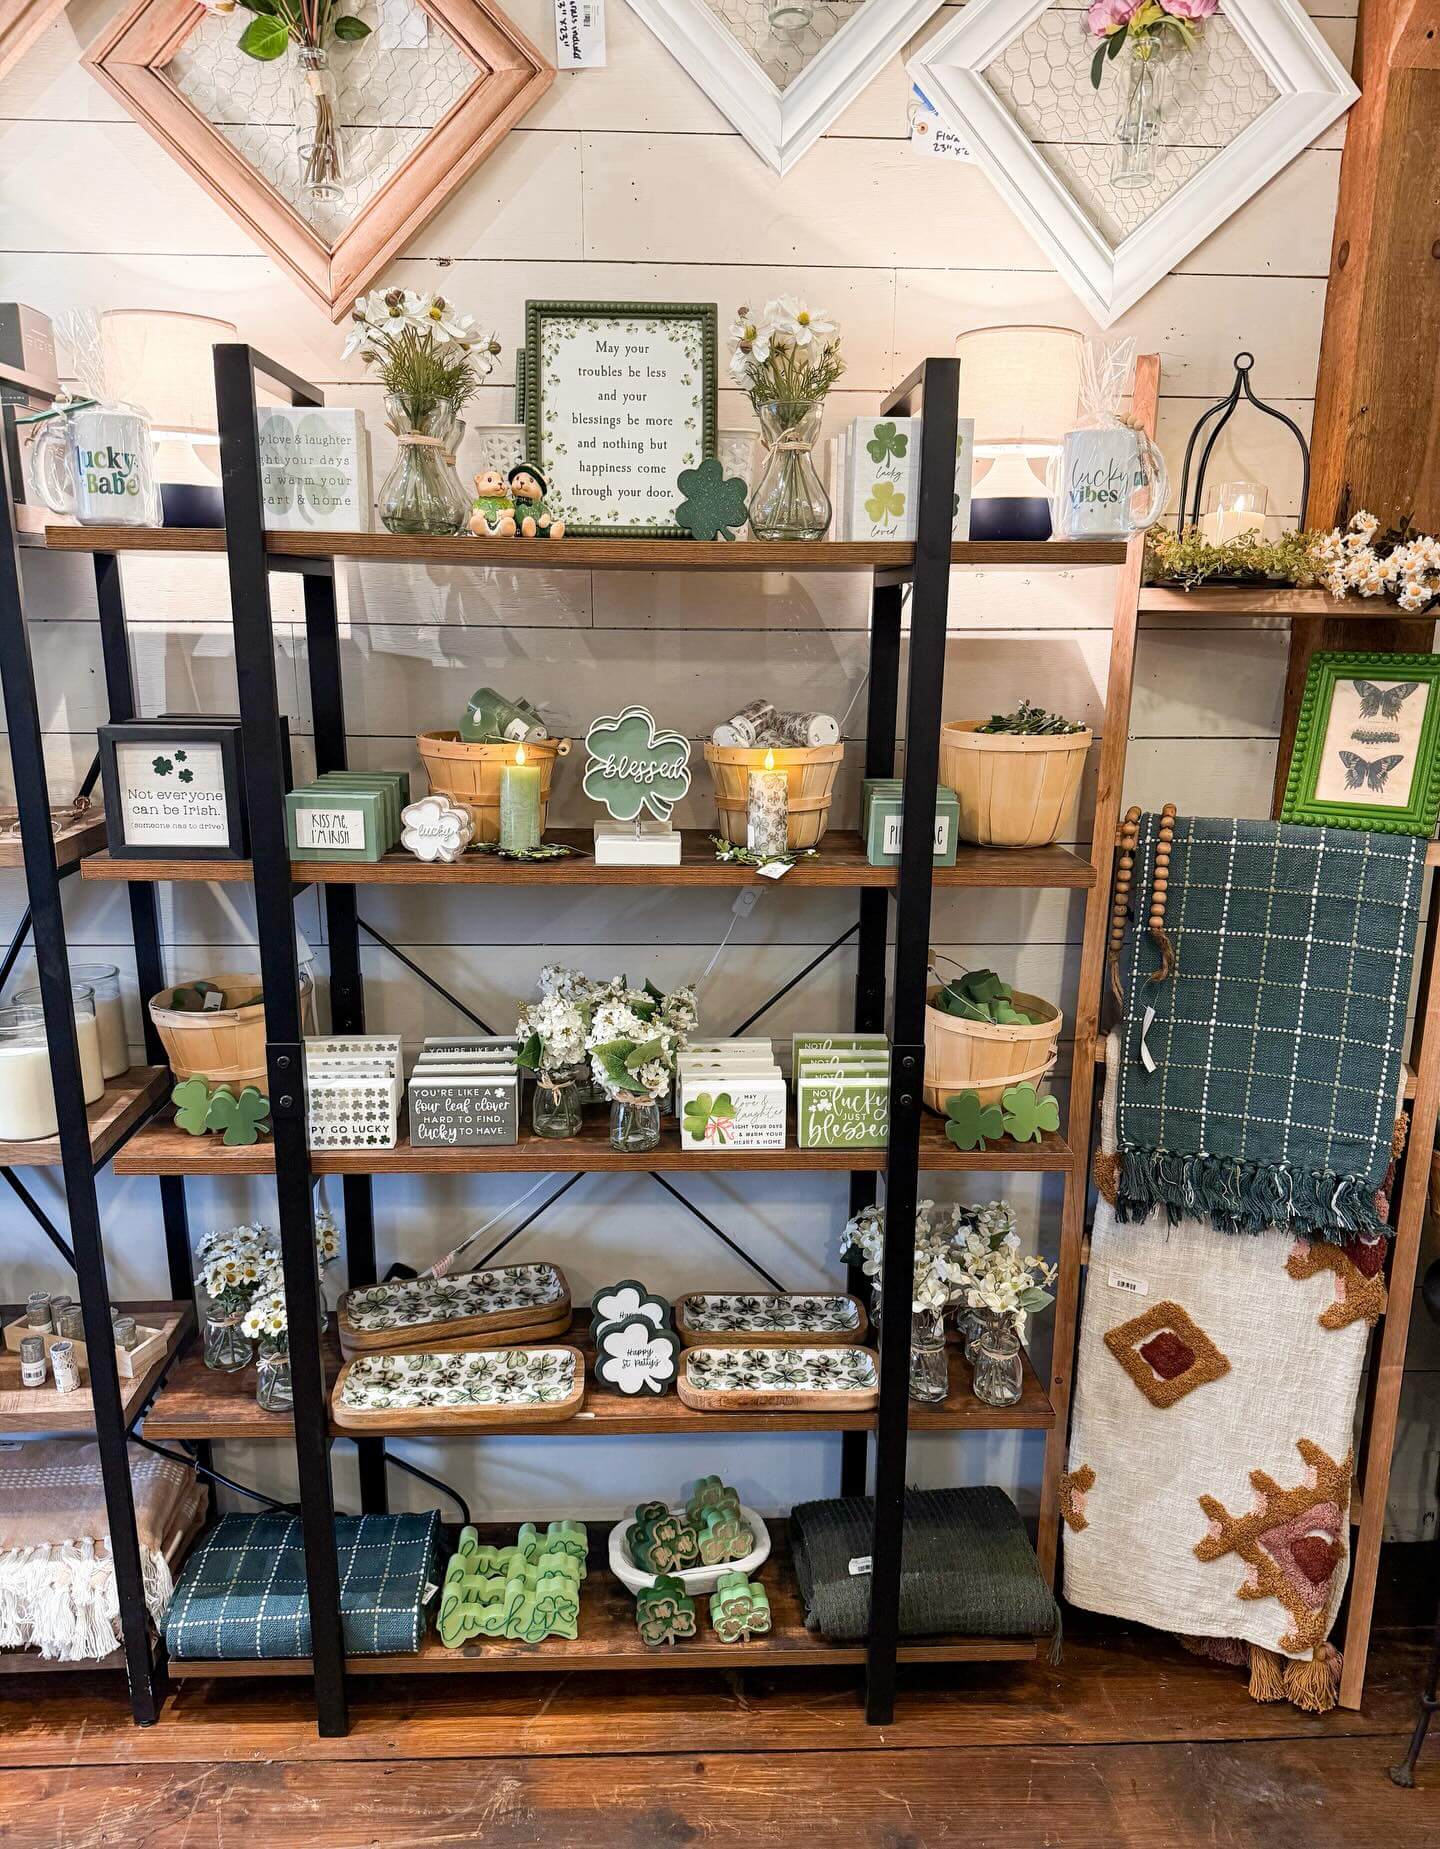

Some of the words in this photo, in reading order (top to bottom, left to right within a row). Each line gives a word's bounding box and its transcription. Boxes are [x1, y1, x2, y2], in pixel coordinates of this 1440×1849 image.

[595, 340, 620, 357] May
[624, 345, 650, 357] your
[578, 365, 623, 377] troubles
[628, 365, 641, 378] be
[647, 366, 667, 378] less
[597, 389, 617, 401] and
[622, 393, 648, 405] your
[571, 412, 621, 430] blessings
[627, 413, 640, 426] be
[645, 418, 673, 426] more
[267, 434, 292, 445] love
[294, 434, 301, 445] &
[304, 434, 352, 447] laughter
[577, 436, 597, 449] and
[602, 437, 644, 454] nothing
[650, 438, 668, 450] but
[284, 456, 315, 467] your
[319, 455, 350, 467] days
[579, 460, 632, 477] happiness
[637, 465, 667, 474] come
[278, 476, 316, 486] warm
[320, 476, 352, 488] your
[875, 465, 904, 483] lucky
[1071, 457, 1129, 496] lucky
[87, 471, 140, 496] Babe
[297, 494, 305, 505] &
[312, 494, 352, 506] home
[571, 484, 613, 501] through
[617, 489, 642, 501] your
[646, 485, 674, 498] door.
[870, 524, 898, 538] loved
[602, 753, 685, 784] blessed
[127, 788, 154, 800] Not
[156, 791, 224, 804] everyone
[132, 805, 159, 815] can
[162, 804, 180, 815] be
[183, 804, 221, 816] Irish.
[311, 813, 331, 829] KISS
[311, 829, 327, 844] I'M
[328, 830, 350, 845] IRISH
[418, 823, 455, 842] lucky
[804, 1042, 824, 1050] NOT
[413, 1088, 454, 1097] YOU'RE
[457, 1088, 480, 1096] LIKE
[483, 1088, 491, 1096] A
[414, 1098, 441, 1115] four
[445, 1097, 471, 1114] leaf
[474, 1097, 511, 1113] clover
[812, 1089, 833, 1097] NOT
[831, 1085, 888, 1121] lucky
[423, 1116, 454, 1124] HARD
[457, 1115, 473, 1124] TO
[476, 1115, 505, 1124] FIND,
[842, 1113, 867, 1121] JUST
[330, 1125, 348, 1134] GO
[352, 1125, 390, 1134] LUCKY
[418, 1123, 458, 1144] lucky
[459, 1127, 473, 1136] TO
[476, 1126, 507, 1136] HAVE.
[626, 1347, 654, 1357] Happy
[439, 1593, 571, 1642] lucky
